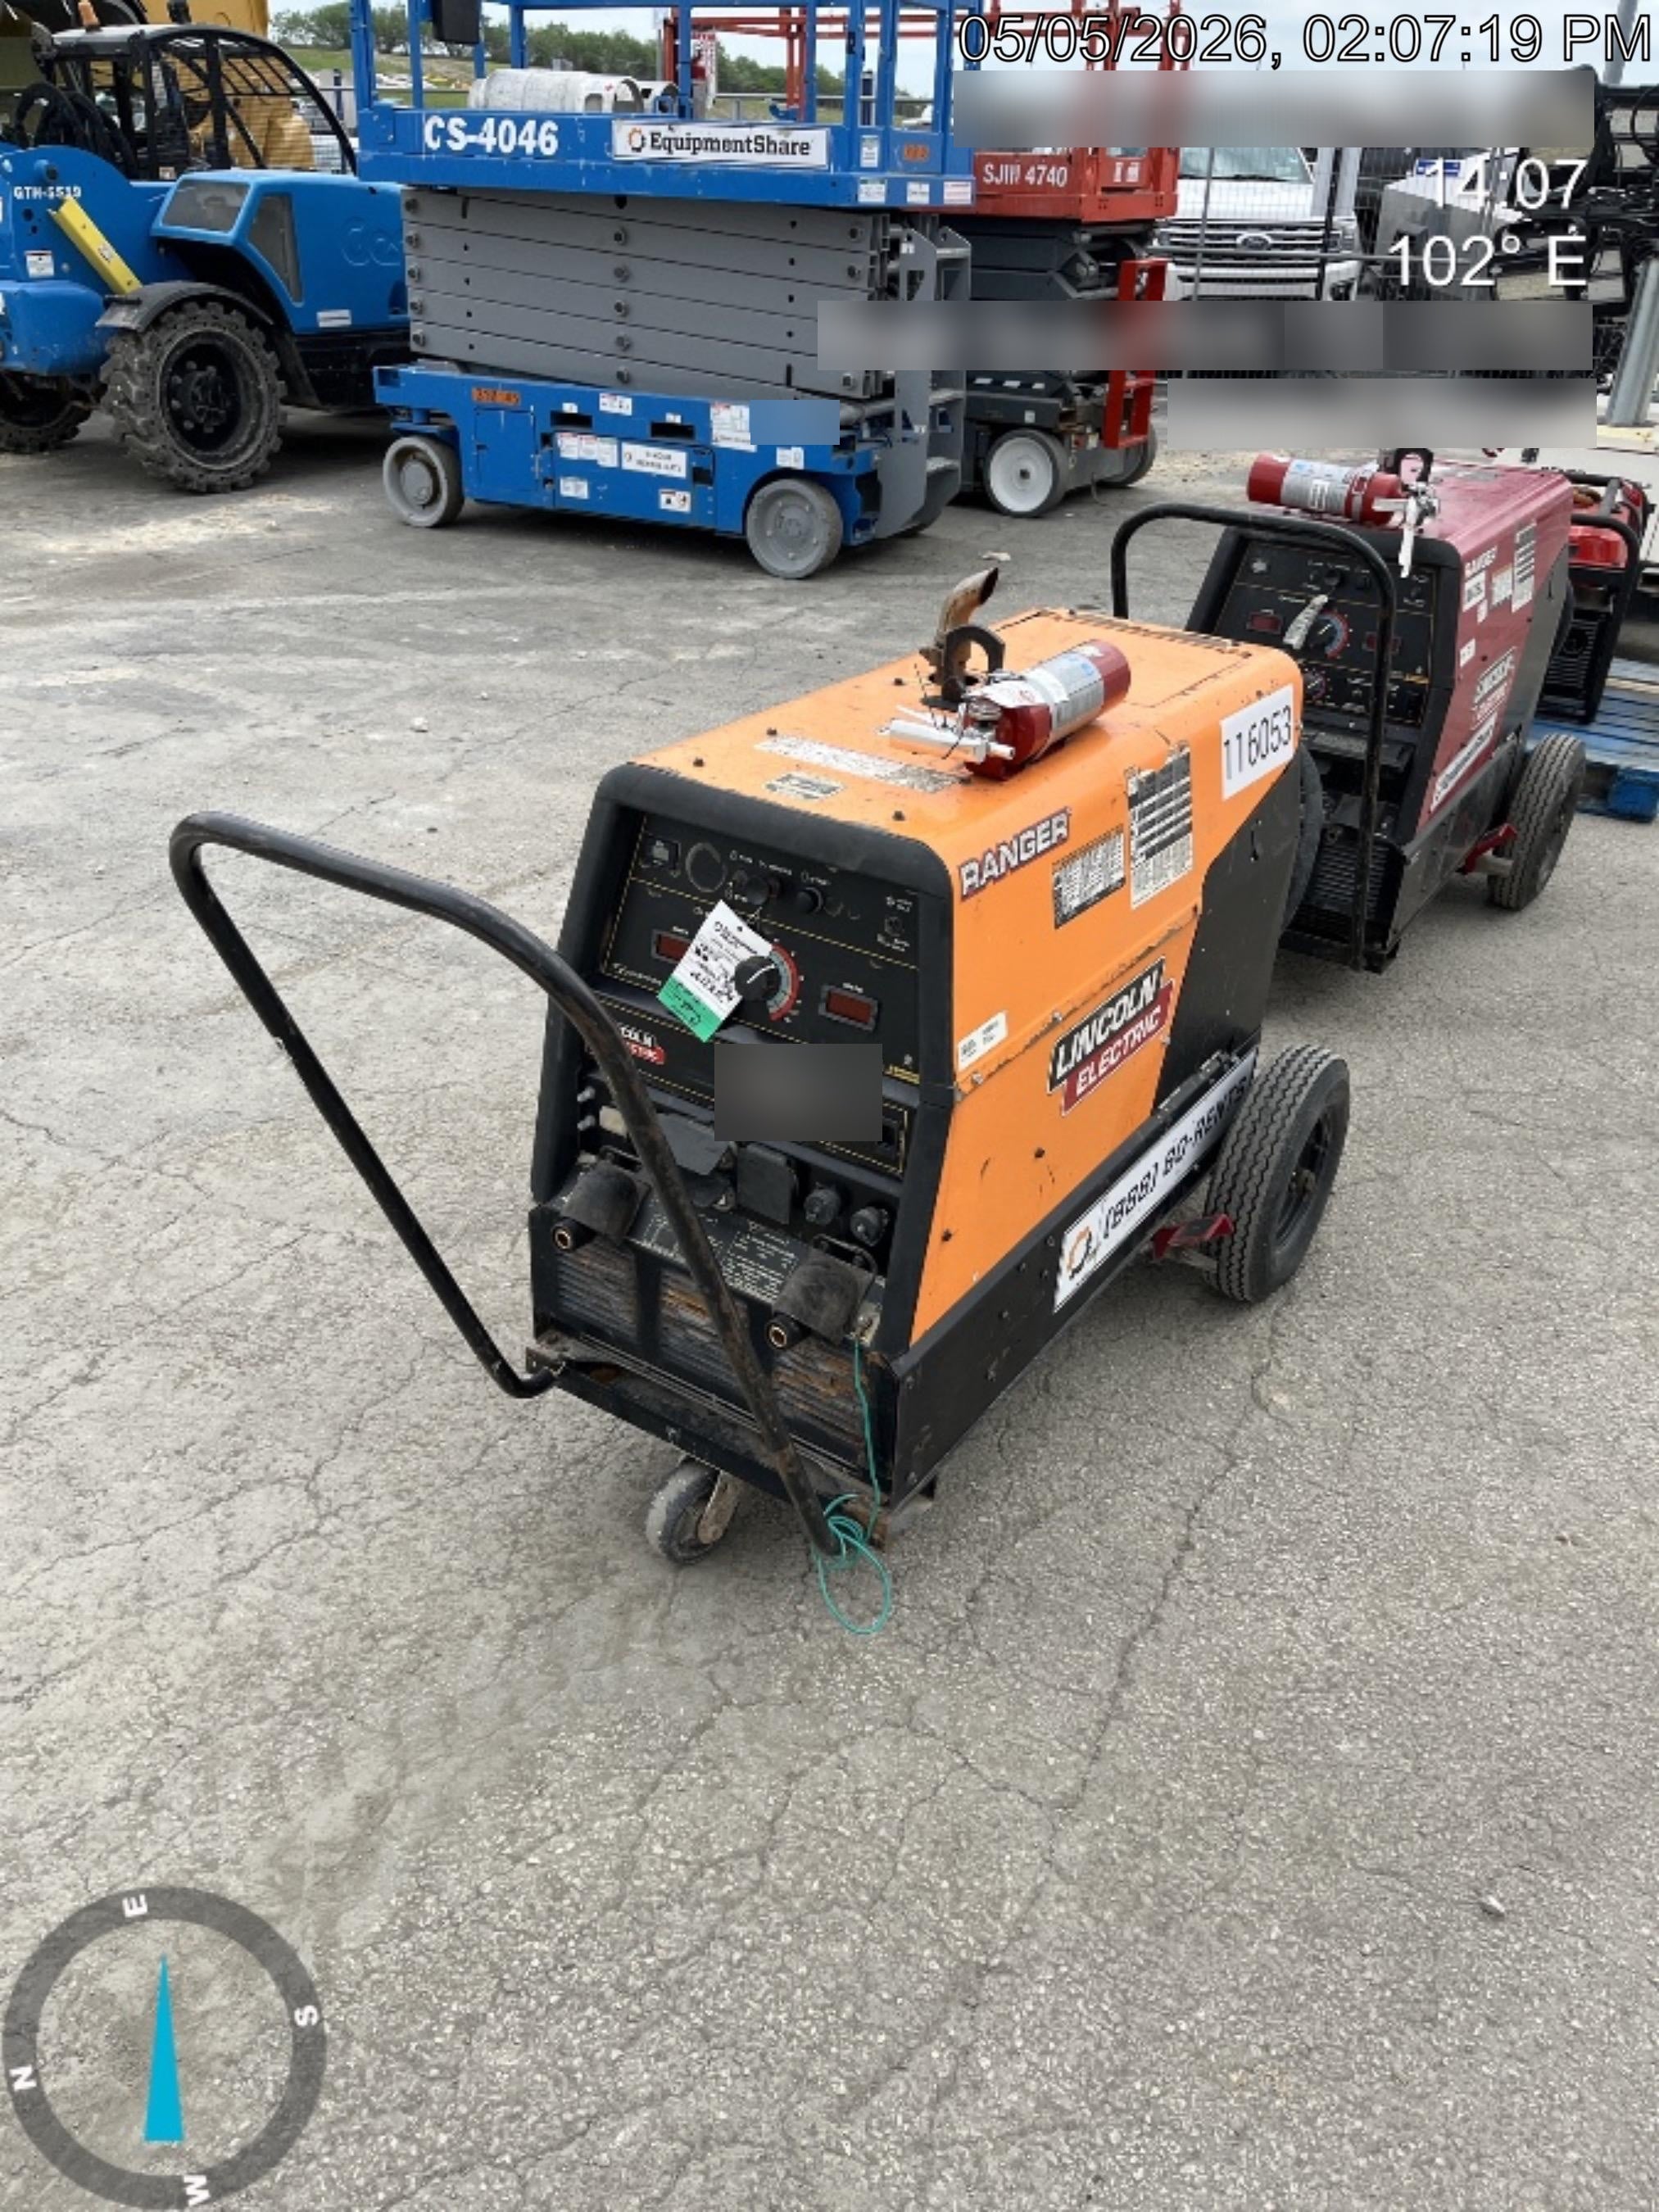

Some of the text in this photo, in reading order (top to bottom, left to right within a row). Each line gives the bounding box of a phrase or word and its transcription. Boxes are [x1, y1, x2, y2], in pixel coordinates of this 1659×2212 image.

[424, 116, 560, 156] CS-4046
[650, 132, 810, 156] EquipmentShare
[1025, 165, 1067, 188] 4740
[1224, 705, 1291, 780] 116053
[959, 808, 1069, 900] RANGER
[1056, 969, 1158, 1080] LINCOLN
[1076, 1005, 1161, 1096] ELECTRIC
